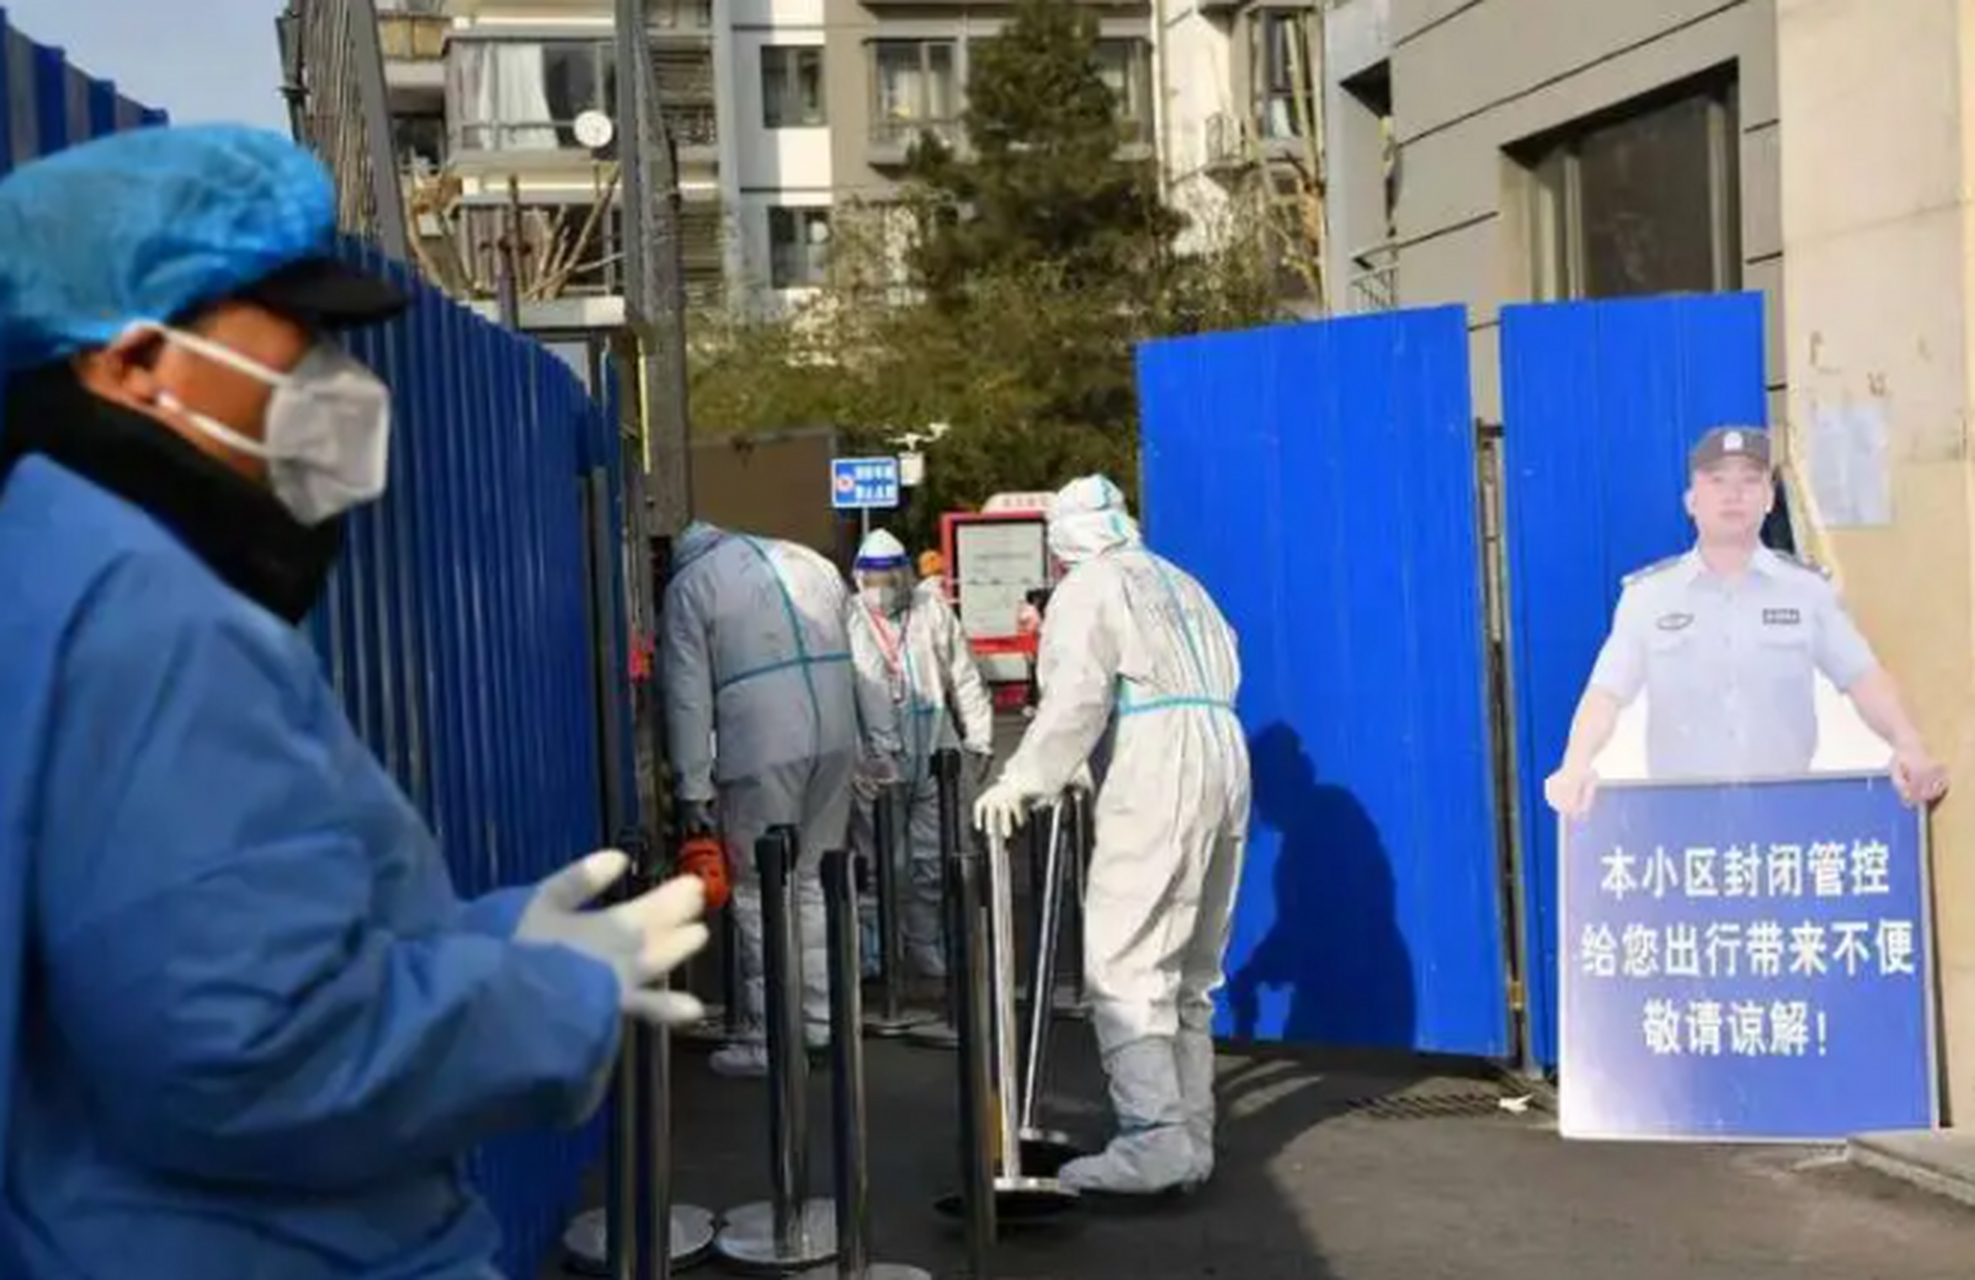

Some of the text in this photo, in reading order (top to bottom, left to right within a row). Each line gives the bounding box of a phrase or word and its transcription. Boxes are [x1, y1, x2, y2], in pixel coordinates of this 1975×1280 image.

[1600, 839, 1890, 899] 本小区封闭管控
[1580, 919, 1915, 978] 给您出行带来不便
